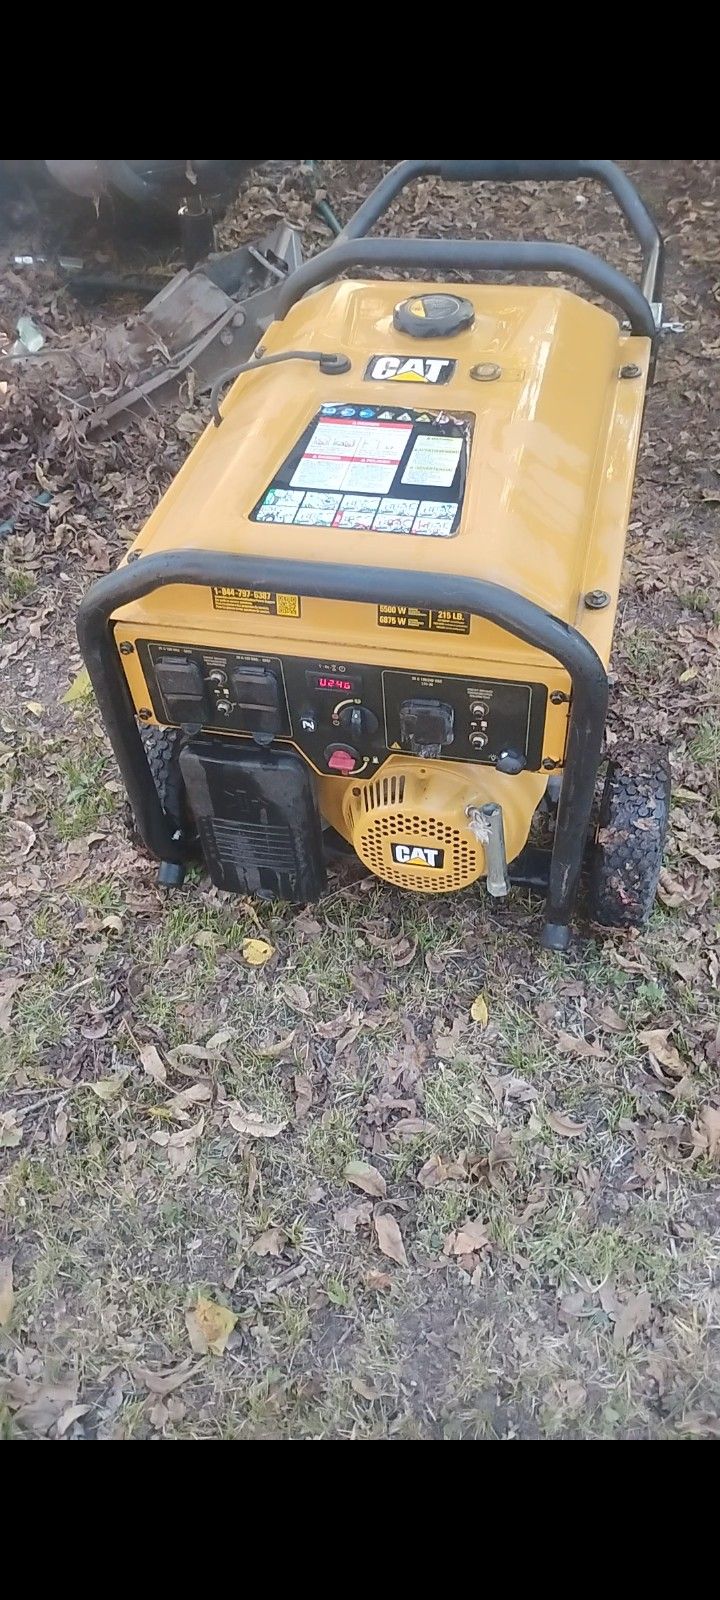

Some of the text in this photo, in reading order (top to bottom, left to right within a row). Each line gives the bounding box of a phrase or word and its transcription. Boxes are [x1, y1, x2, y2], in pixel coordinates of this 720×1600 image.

[371, 357, 450, 383] CAT
[397, 606, 407, 615] W
[438, 610, 451, 620] 215
[452, 612, 465, 621] LB.
[397, 617, 407, 626] W
[395, 845, 439, 867] CAT
